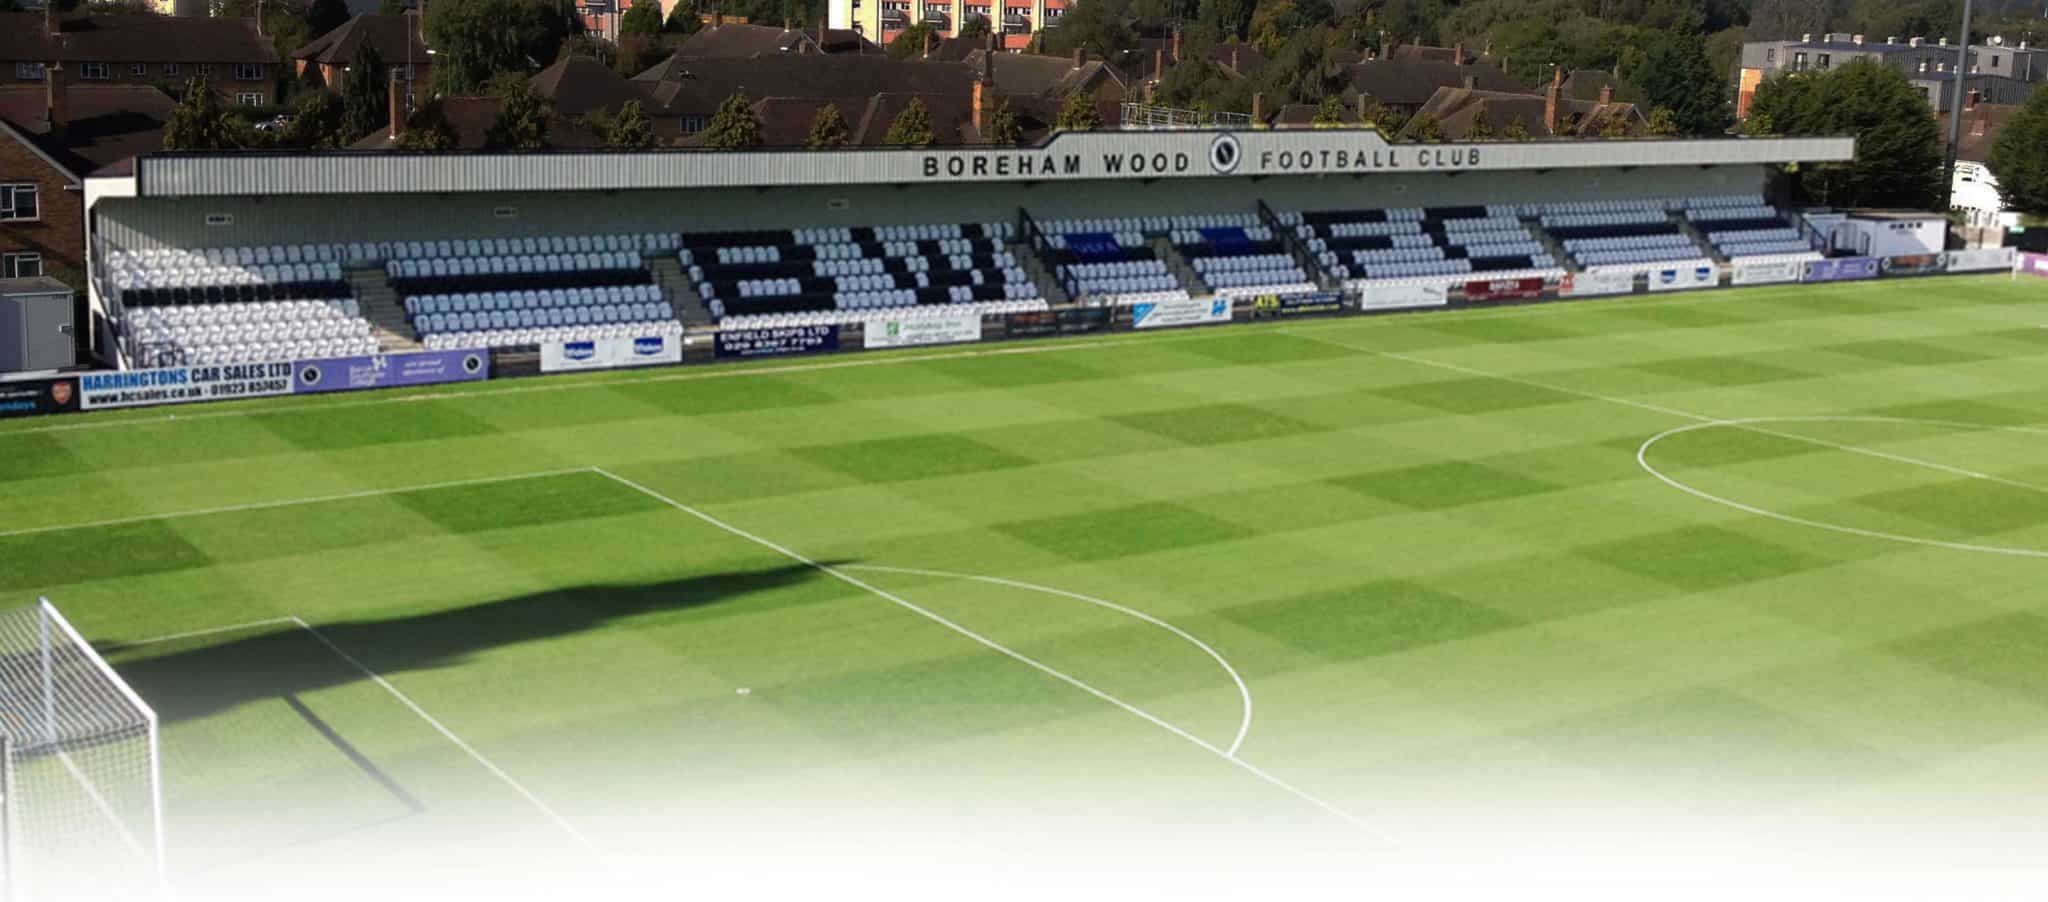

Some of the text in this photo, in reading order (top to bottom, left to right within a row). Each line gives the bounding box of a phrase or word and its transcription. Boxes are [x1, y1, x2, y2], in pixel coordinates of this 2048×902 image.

[923, 147, 1481, 176] BOREHAM WOOD FOOTBALL CLUB
[721, 329, 769, 342] ENFIELD
[807, 324, 830, 335] LTD
[83, 361, 291, 390] HARRINGTONS CAR SALES LTD
